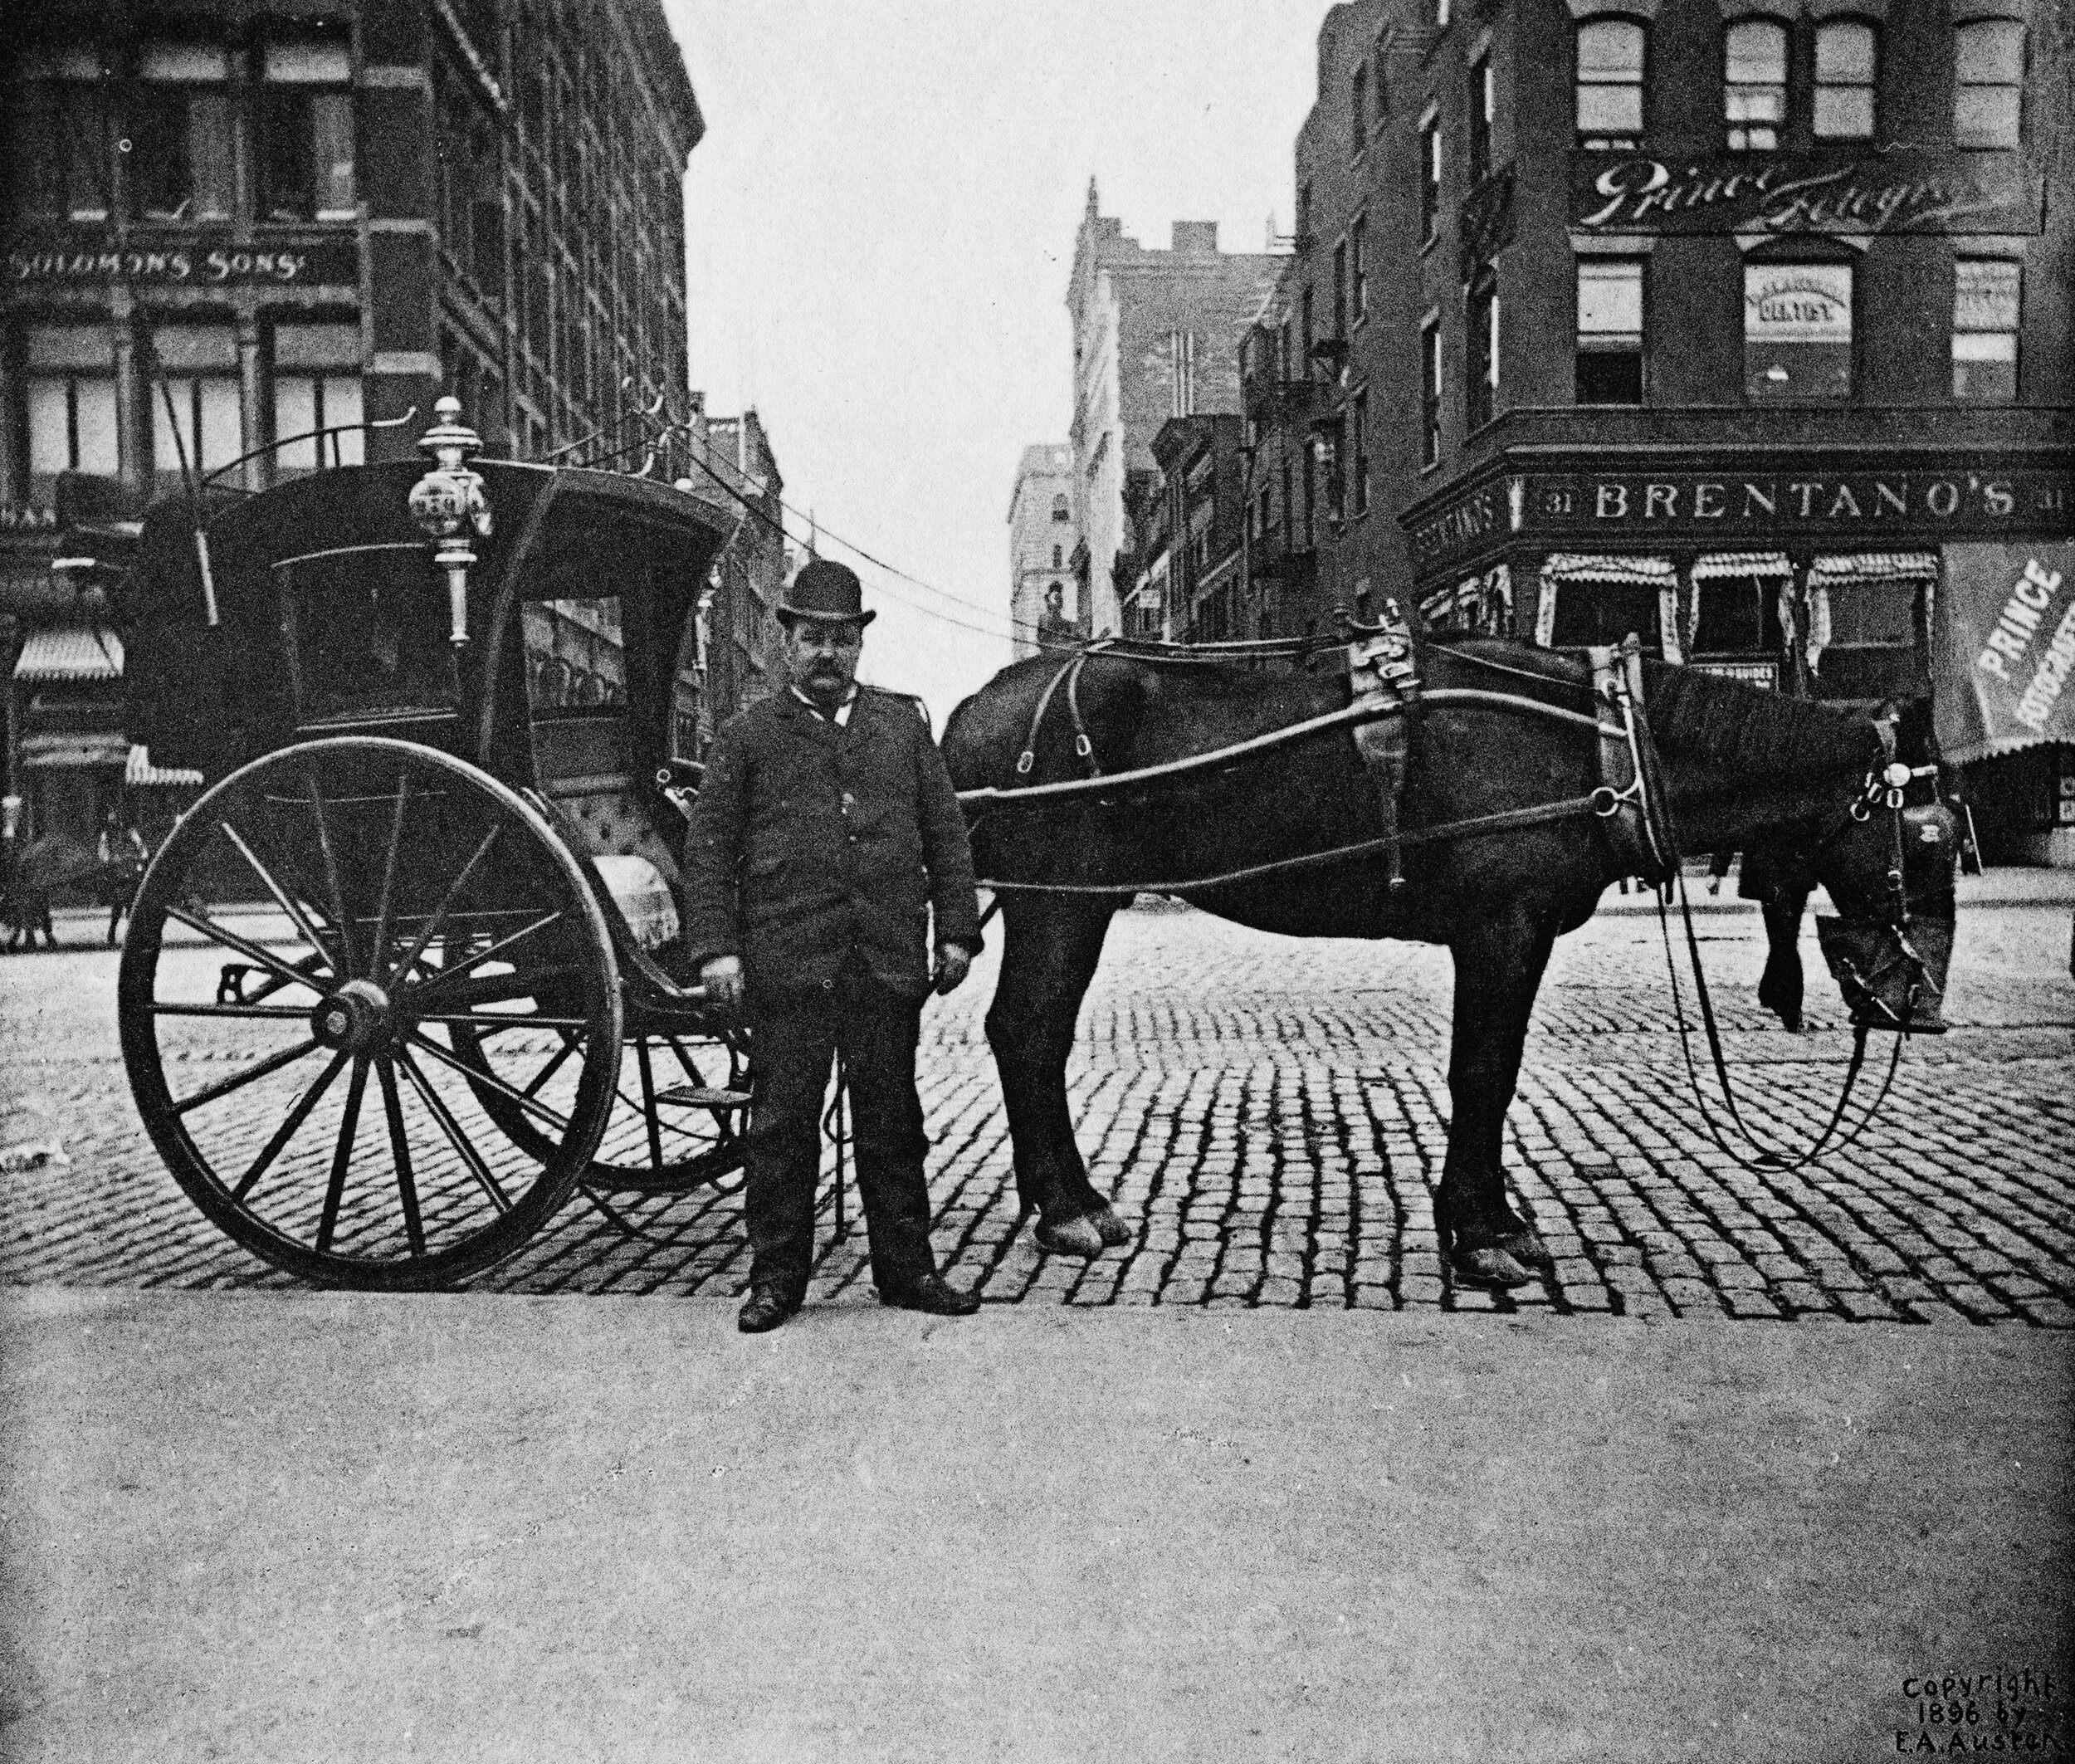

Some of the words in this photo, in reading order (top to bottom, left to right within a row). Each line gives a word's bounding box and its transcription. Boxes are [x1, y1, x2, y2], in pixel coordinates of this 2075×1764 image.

[1545, 492, 1571, 513] 31
[1596, 476, 2014, 518] BRENTANO'S
[1979, 559, 2062, 682] PRINCE
